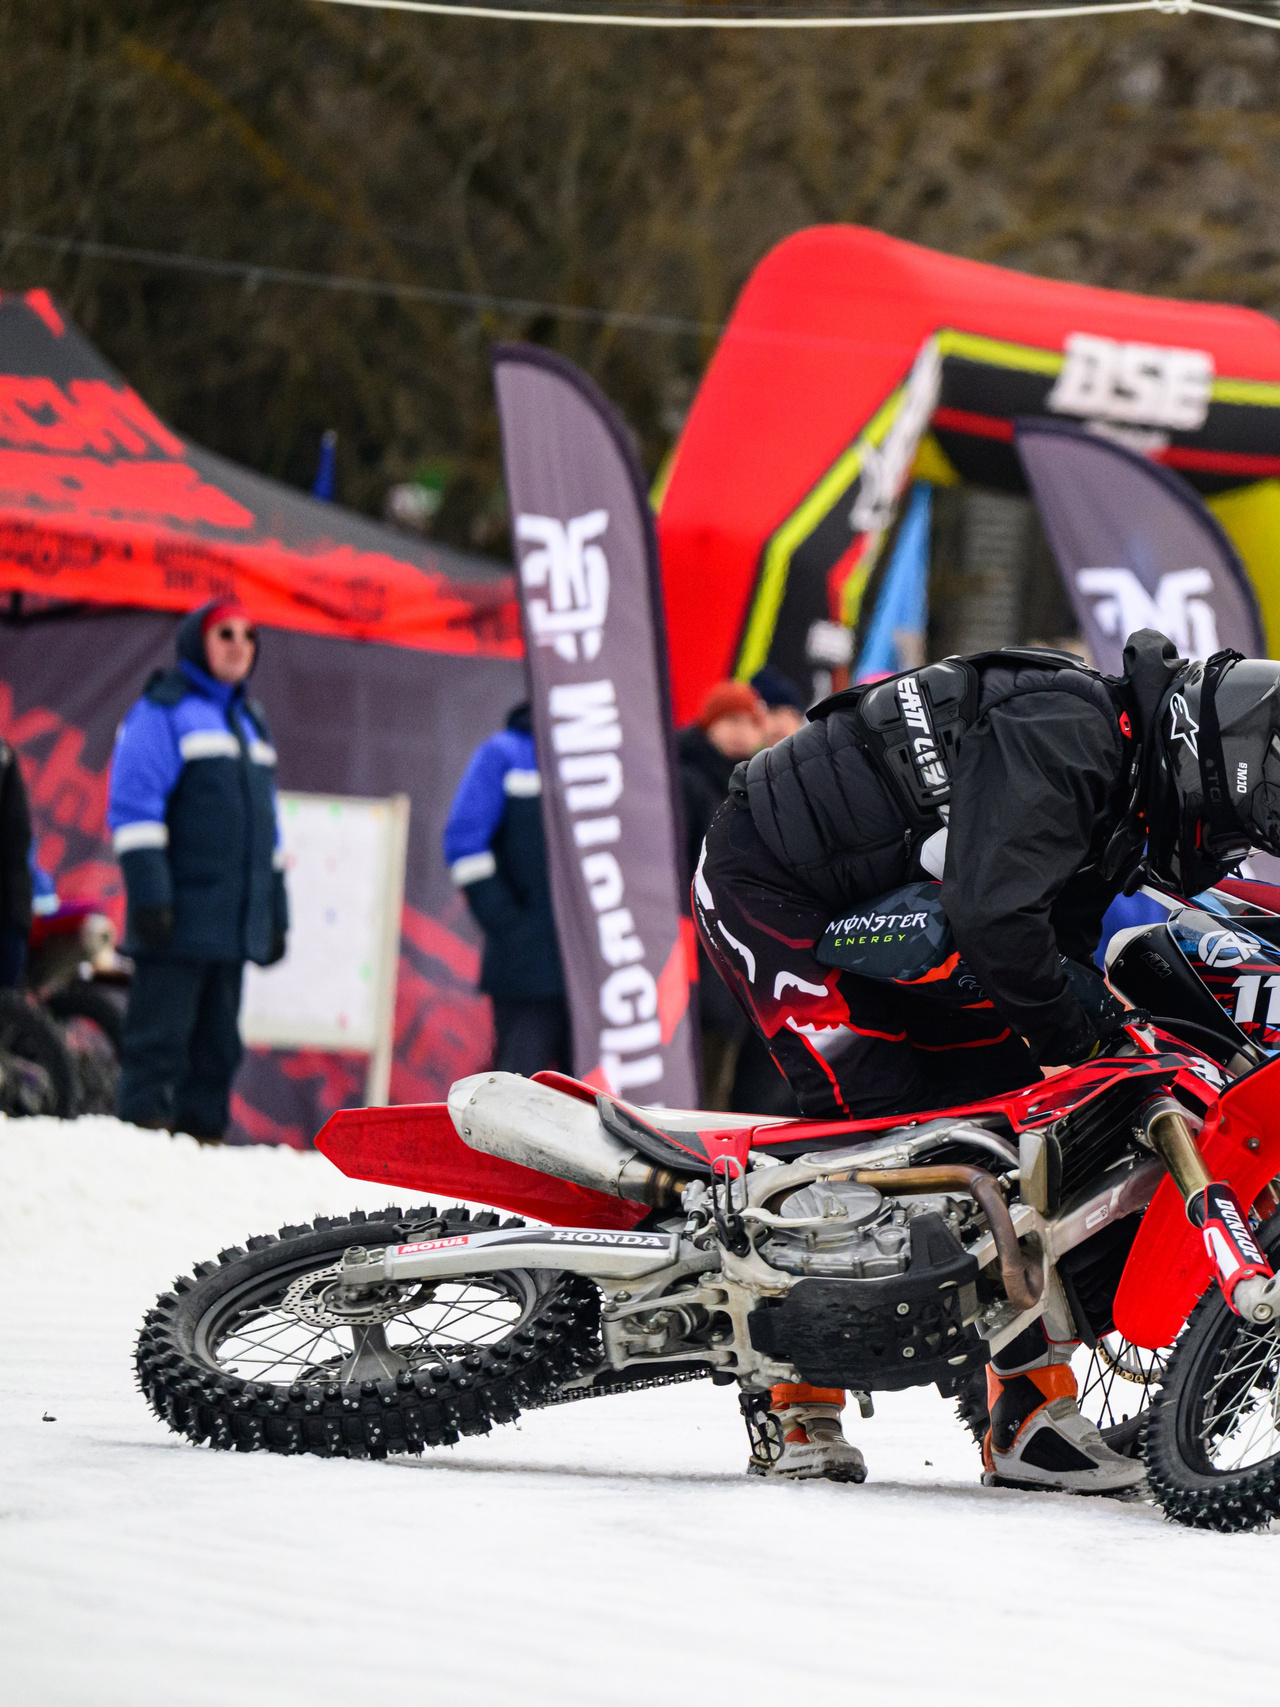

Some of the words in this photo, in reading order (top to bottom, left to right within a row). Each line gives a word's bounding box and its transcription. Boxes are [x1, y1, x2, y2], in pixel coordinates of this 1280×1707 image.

[825, 913, 927, 935] MONSTER
[835, 934, 906, 947] ENERGY
[550, 1231, 664, 1247] HONDA
[1214, 1197, 1263, 1265] DUNLOP
[400, 1237, 467, 1254] MOTUL
